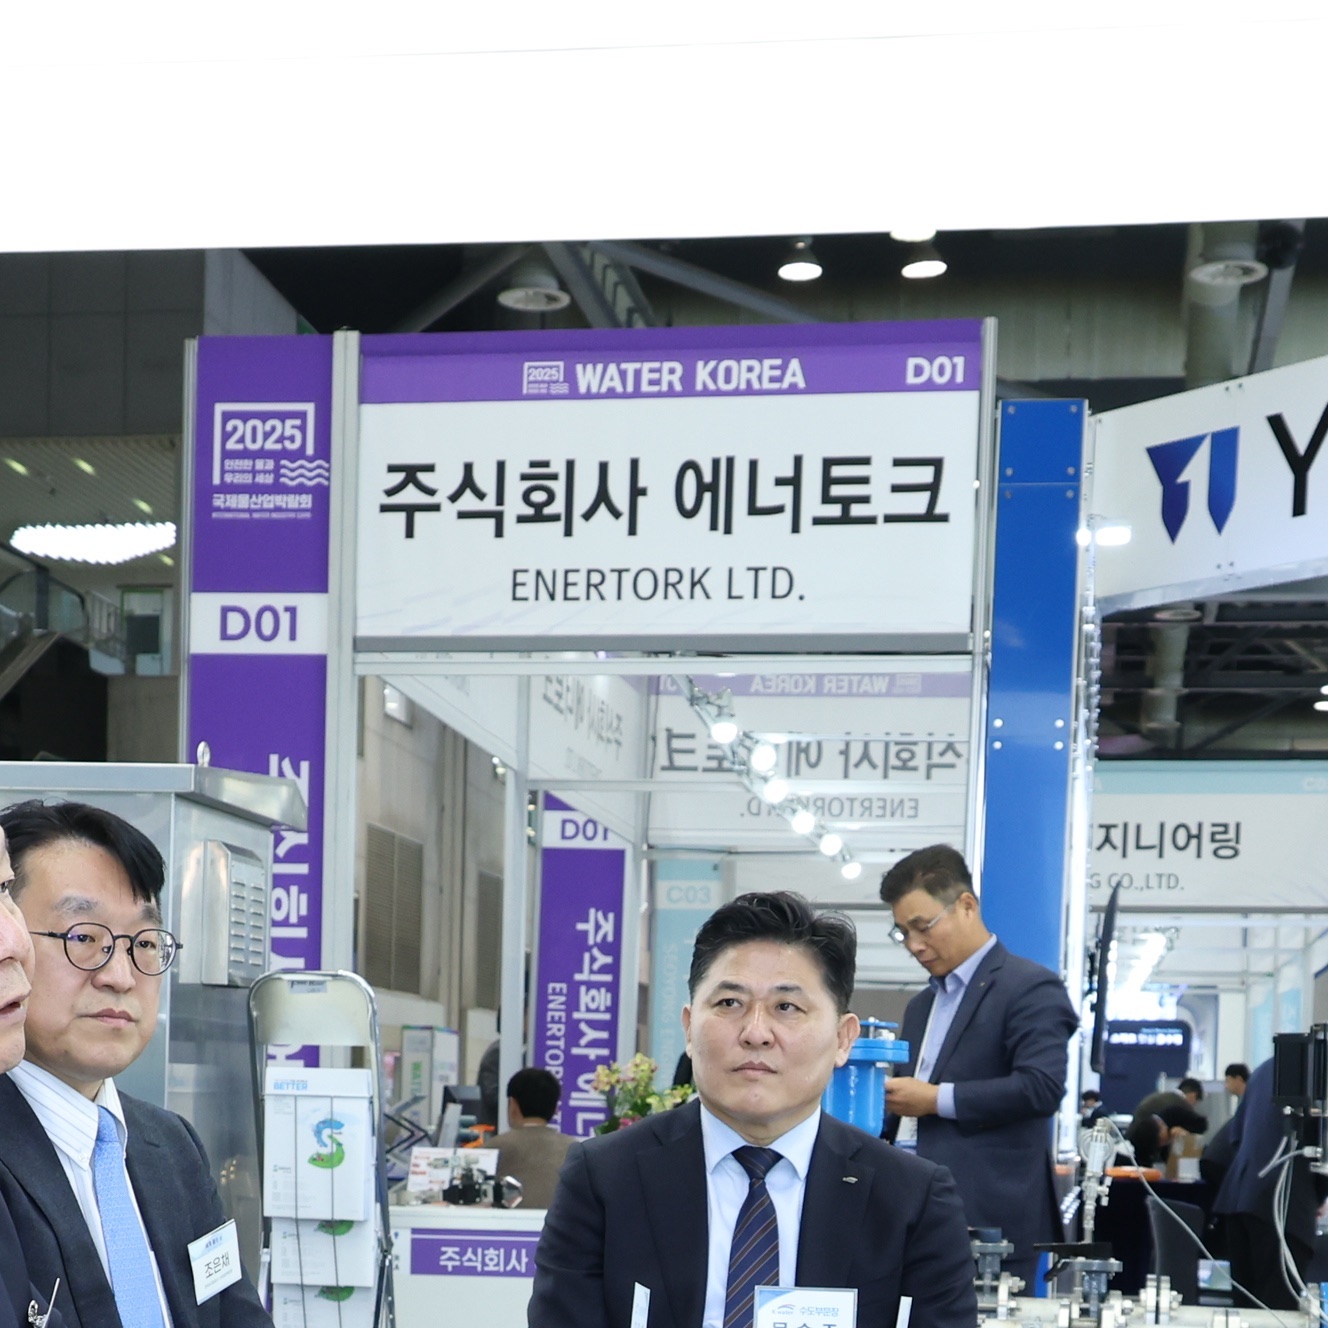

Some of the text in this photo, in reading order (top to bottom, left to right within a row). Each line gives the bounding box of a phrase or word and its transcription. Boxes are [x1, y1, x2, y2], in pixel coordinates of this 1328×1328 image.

[528, 367, 559, 381] 2025
[575, 358, 806, 393] WATER KOREA
[905, 356, 966, 385] D01
[225, 418, 302, 450] 2025
[379, 453, 951, 540] 주식회사 에너토크
[510, 565, 806, 602] ENERTORK LTD.
[220, 604, 298, 642] D01
[666, 885, 712, 904] C03
[571, 907, 615, 1061] 주식회사
[274, 1081, 308, 1091] BETTER
[204, 1251, 230, 1279] 조은채
[438, 1246, 529, 1273] 주식회사
[799, 1306, 840, 1317] 수도부문장
